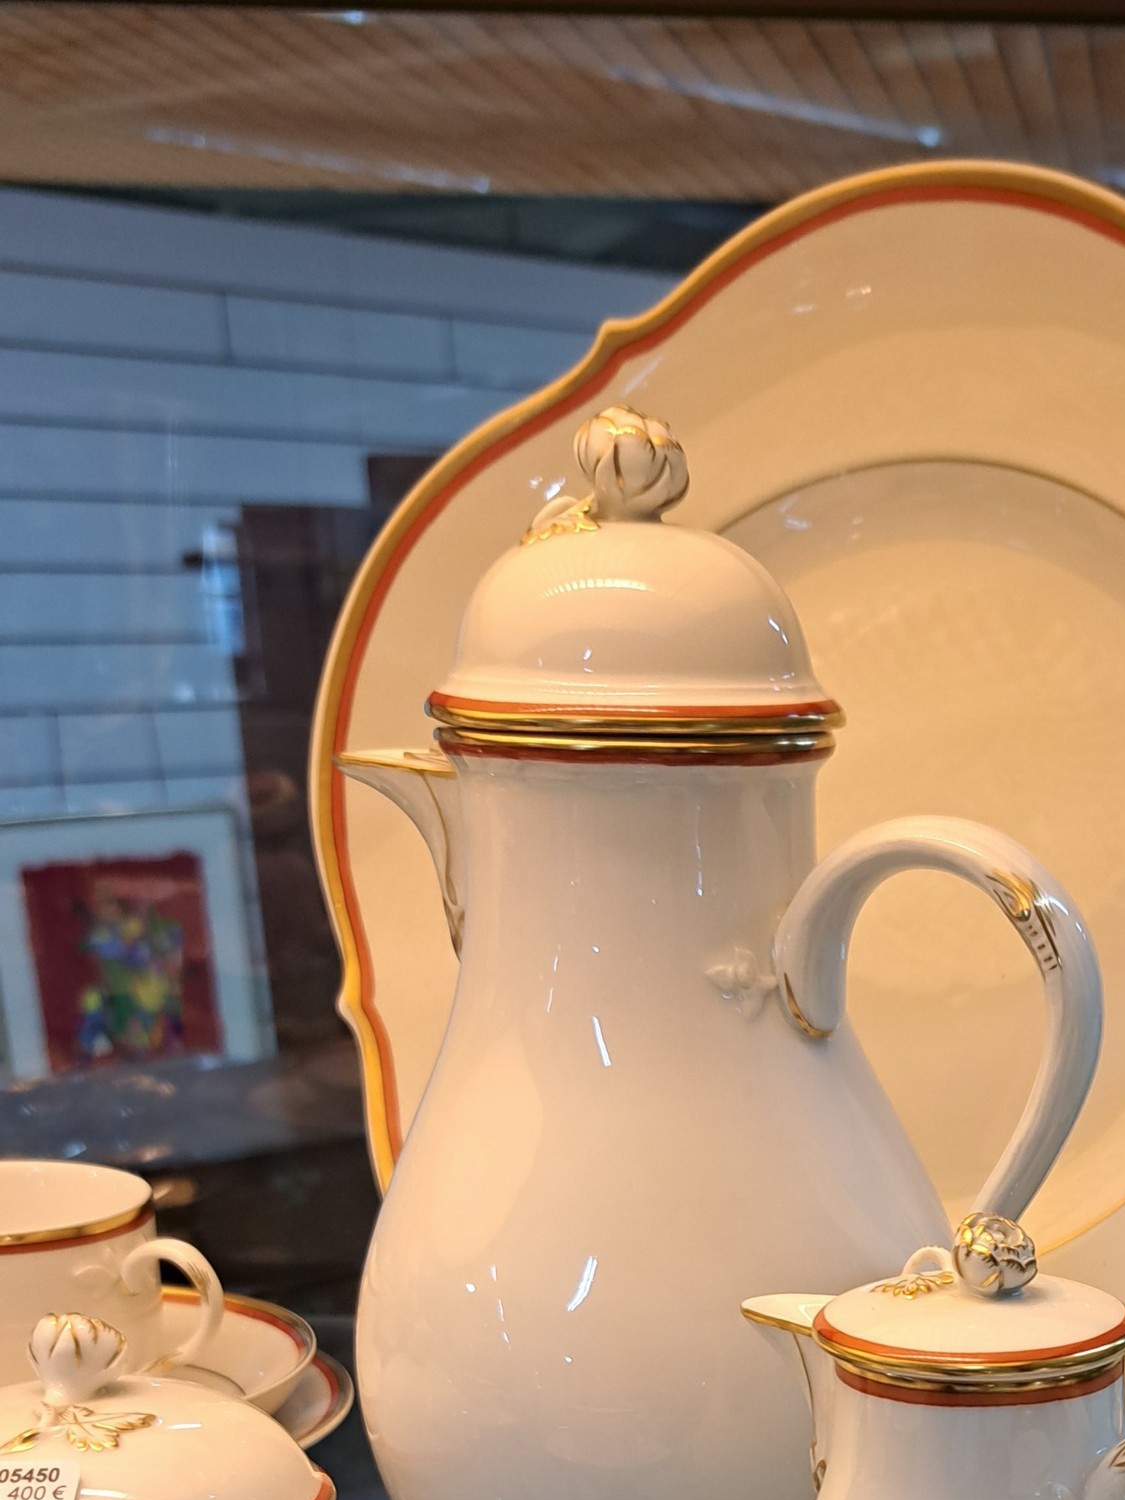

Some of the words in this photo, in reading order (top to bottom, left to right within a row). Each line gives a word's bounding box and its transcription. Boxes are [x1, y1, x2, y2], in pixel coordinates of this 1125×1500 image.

[0, 1467, 60, 1483] 05450
[7, 1486, 46, 1500] 400
[52, 1485, 67, 1500] €
